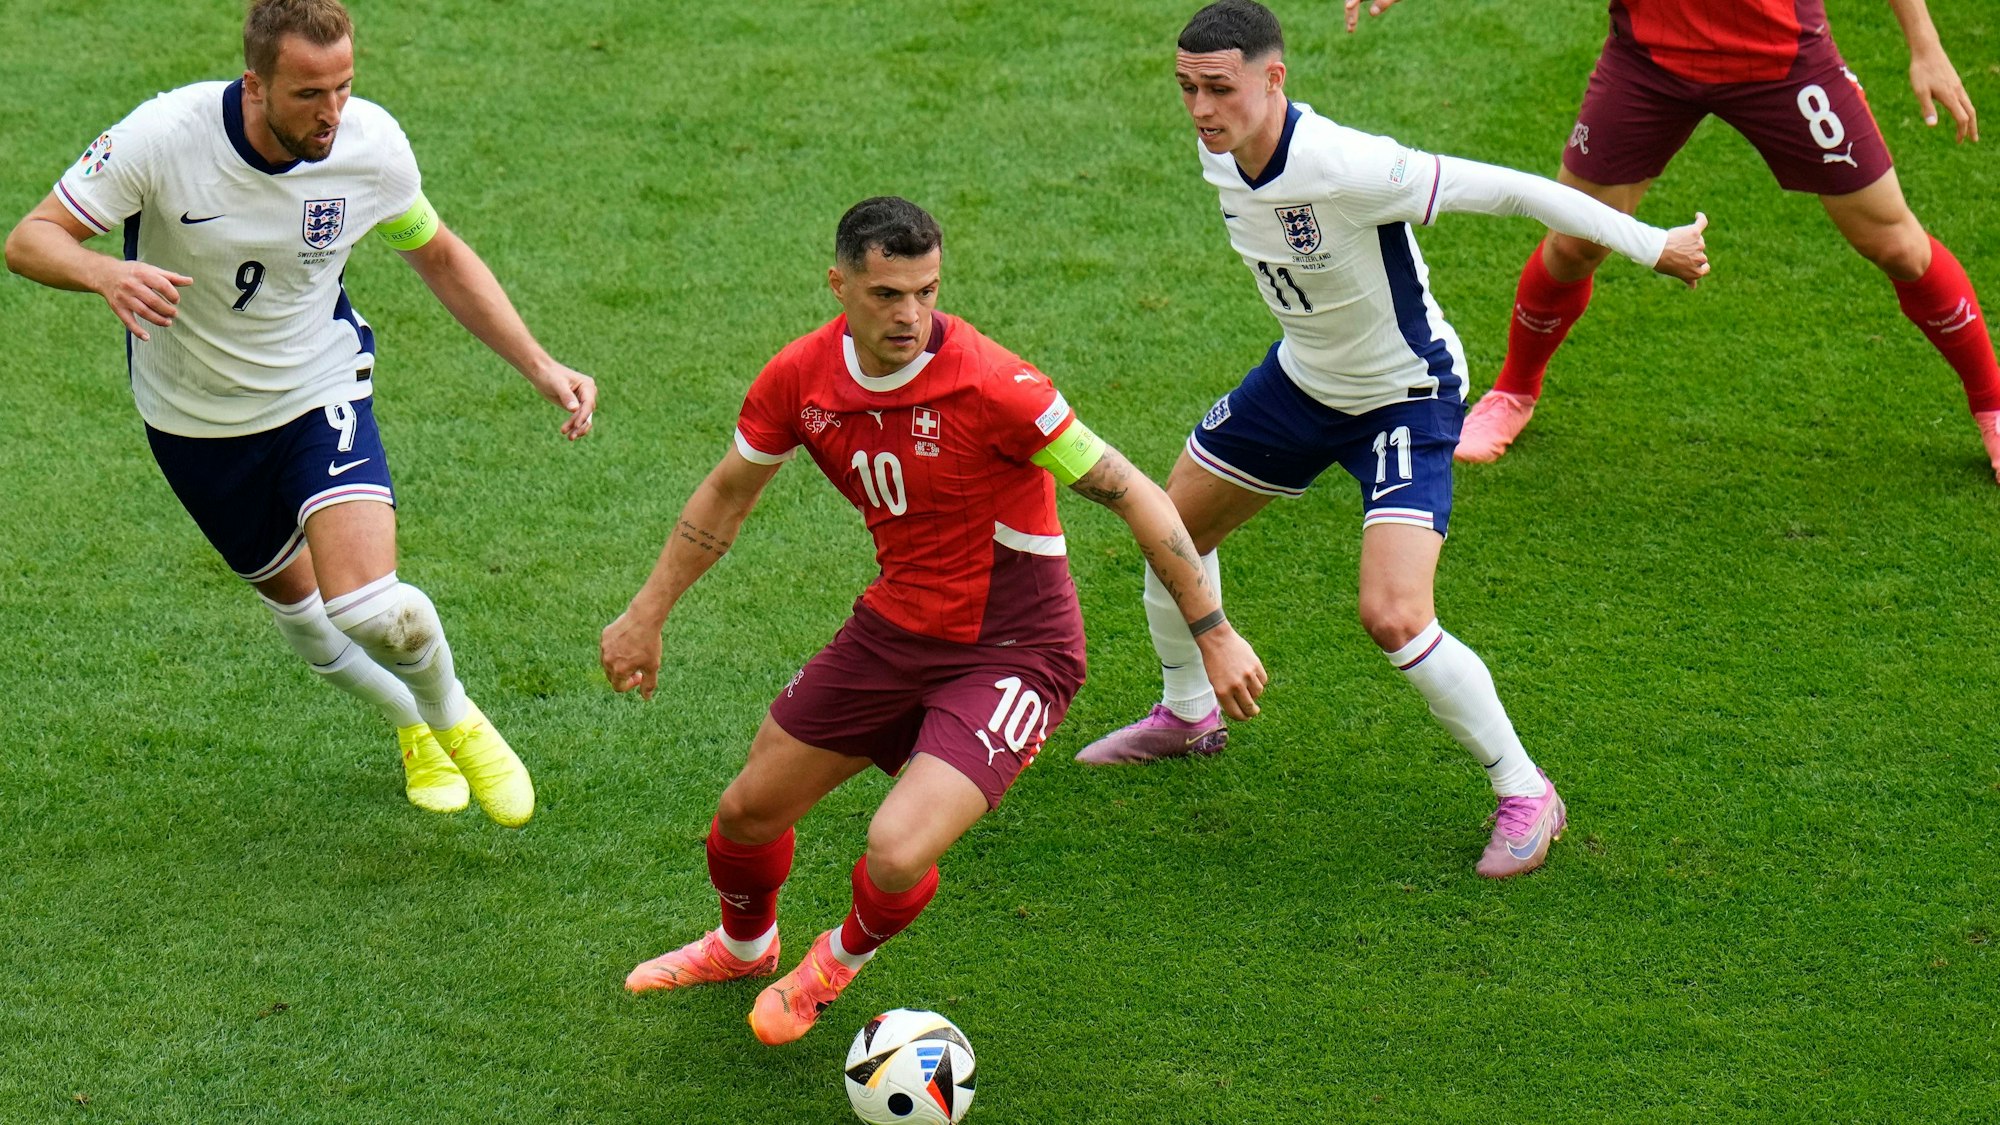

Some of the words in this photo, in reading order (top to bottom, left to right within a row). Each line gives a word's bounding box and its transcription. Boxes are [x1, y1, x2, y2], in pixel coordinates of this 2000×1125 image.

[1797, 84, 1845, 149] 8
[391, 211, 428, 240] RESPECT
[297, 249, 336, 258] SWITZERLAND
[1292, 253, 1332, 263] SWITZERLAND
[232, 260, 266, 311] 9
[1258, 261, 1313, 313] 11
[324, 400, 357, 451] 9
[1372, 426, 1412, 483] 11
[852, 450, 908, 516] 10
[988, 676, 1042, 753] 10
